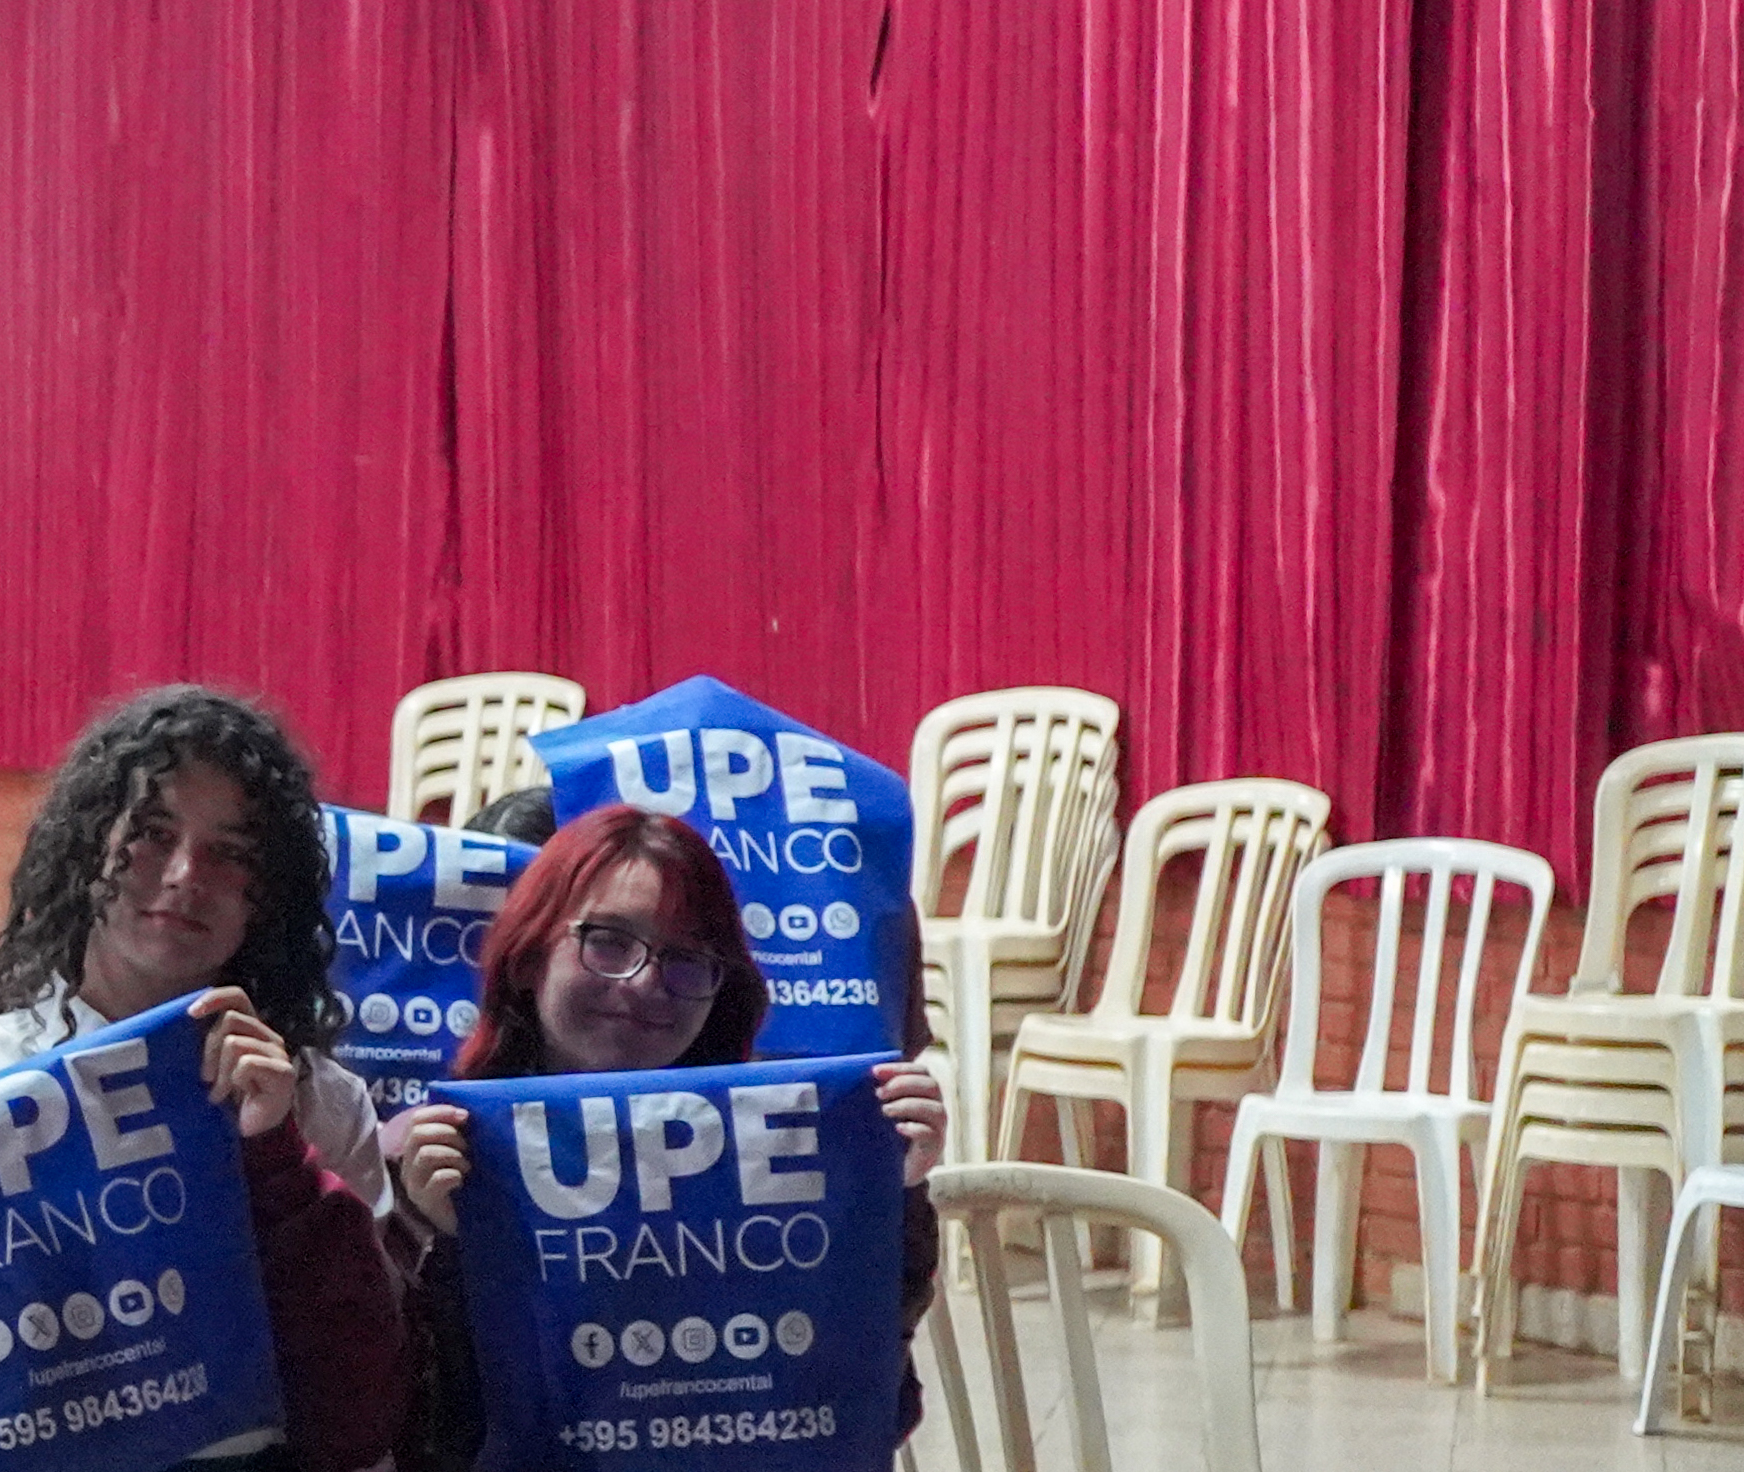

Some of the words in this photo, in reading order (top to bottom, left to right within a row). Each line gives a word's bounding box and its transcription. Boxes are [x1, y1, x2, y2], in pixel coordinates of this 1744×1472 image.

[608, 728, 859, 823] UPE
[709, 827, 862, 874] ANCO
[512, 1082, 826, 1220] UPE
[533, 1212, 831, 1283] FRANCO
[559, 1419, 638, 1451] +595
[649, 1404, 837, 1448] 984364238
